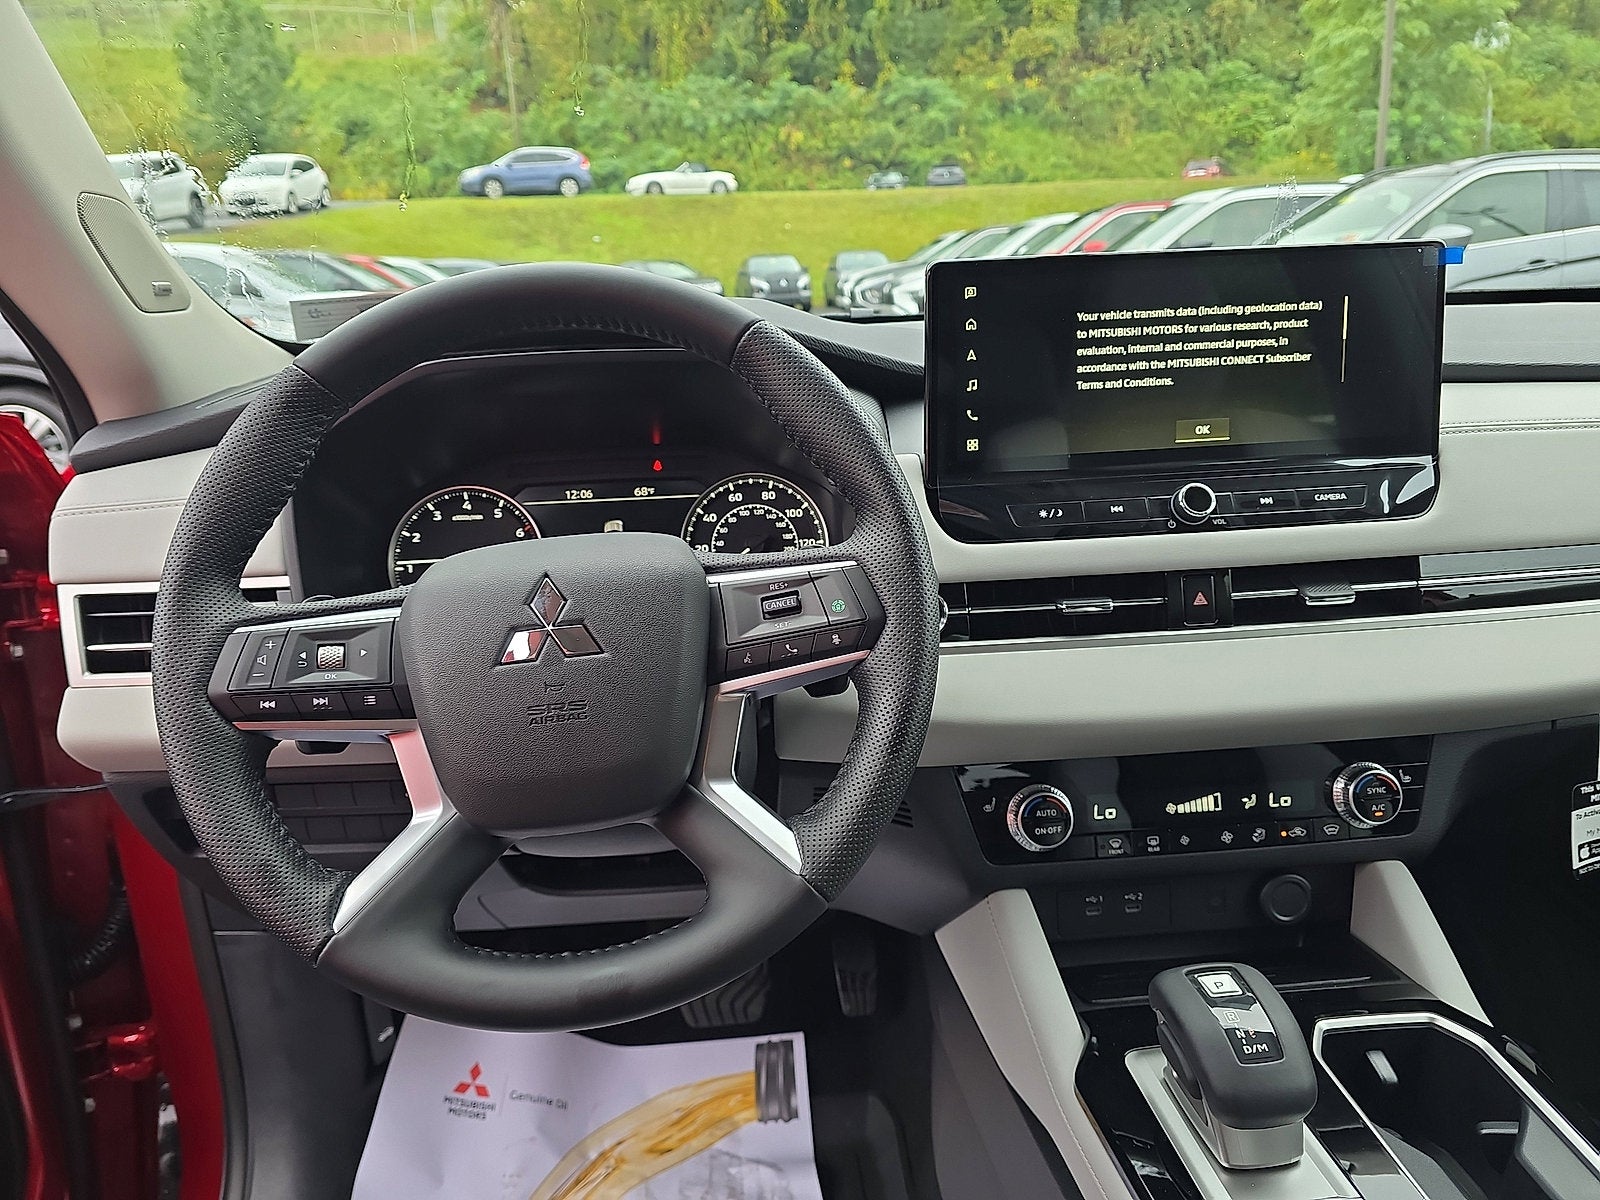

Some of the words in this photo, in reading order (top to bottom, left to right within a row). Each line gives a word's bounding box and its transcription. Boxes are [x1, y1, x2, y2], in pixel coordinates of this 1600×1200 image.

[1077, 312, 1099, 321] Your
[1100, 310, 1132, 320] vehicle
[1133, 308, 1175, 318] transmits
[1176, 307, 1197, 316] data
[1198, 305, 1243, 316] (including
[1244, 302, 1297, 315] geolocation
[1299, 300, 1322, 311] data)
[1077, 329, 1087, 338] to
[1089, 327, 1141, 338] MITSUBISHI
[1143, 325, 1183, 335] MOTORS
[1184, 324, 1198, 333] for
[1200, 323, 1232, 332] various
[1233, 320, 1272, 331] research,
[1273, 319, 1309, 331] product
[1077, 345, 1126, 356] evaluation,
[1127, 343, 1163, 353] internal
[1165, 342, 1182, 351] and
[1183, 339, 1234, 351] commercial
[1235, 338, 1278, 349] purposes,
[1279, 337, 1288, 345] in
[1077, 363, 1127, 373] accordance
[1128, 361, 1149, 370] with
[1150, 360, 1166, 369] the
[1167, 357, 1219, 368] MITSUBISHI
[1221, 354, 1265, 365] CONNECT
[1266, 353, 1312, 363] Subscriber
[1076, 381, 1103, 390] Terms
[1105, 379, 1122, 388] and
[1124, 377, 1174, 387] Conditions.
[1195, 424, 1211, 435] OK
[565, 489, 593, 500] 12:06
[728, 492, 743, 502] 60
[761, 491, 776, 500] 80
[1314, 493, 1347, 502] CAMERA
[462, 500, 472, 510] 4
[432, 511, 442, 521] 3
[493, 508, 503, 519] 5
[702, 513, 717, 522] 40
[785, 509, 803, 518] 100
[411, 532, 421, 543] 2
[515, 527, 525, 538] 6
[799, 539, 816, 548] 120
[406, 564, 414, 574] 1
[769, 581, 788, 591] RES+
[765, 598, 796, 610] CANCEL
[526, 700, 589, 716] SRS
[528, 712, 588, 726] AIRBAG
[1366, 786, 1387, 795] SYNC
[1580, 785, 1594, 794] This
[1268, 792, 1292, 808] Lo
[1093, 803, 1117, 820] Lo
[1371, 803, 1386, 811] A/C
[1036, 808, 1057, 818] AUTO
[1213, 981, 1224, 989] P
[1226, 1012, 1237, 1021] R
[1235, 1029, 1246, 1038] N
[1243, 1043, 1269, 1054] D/M
